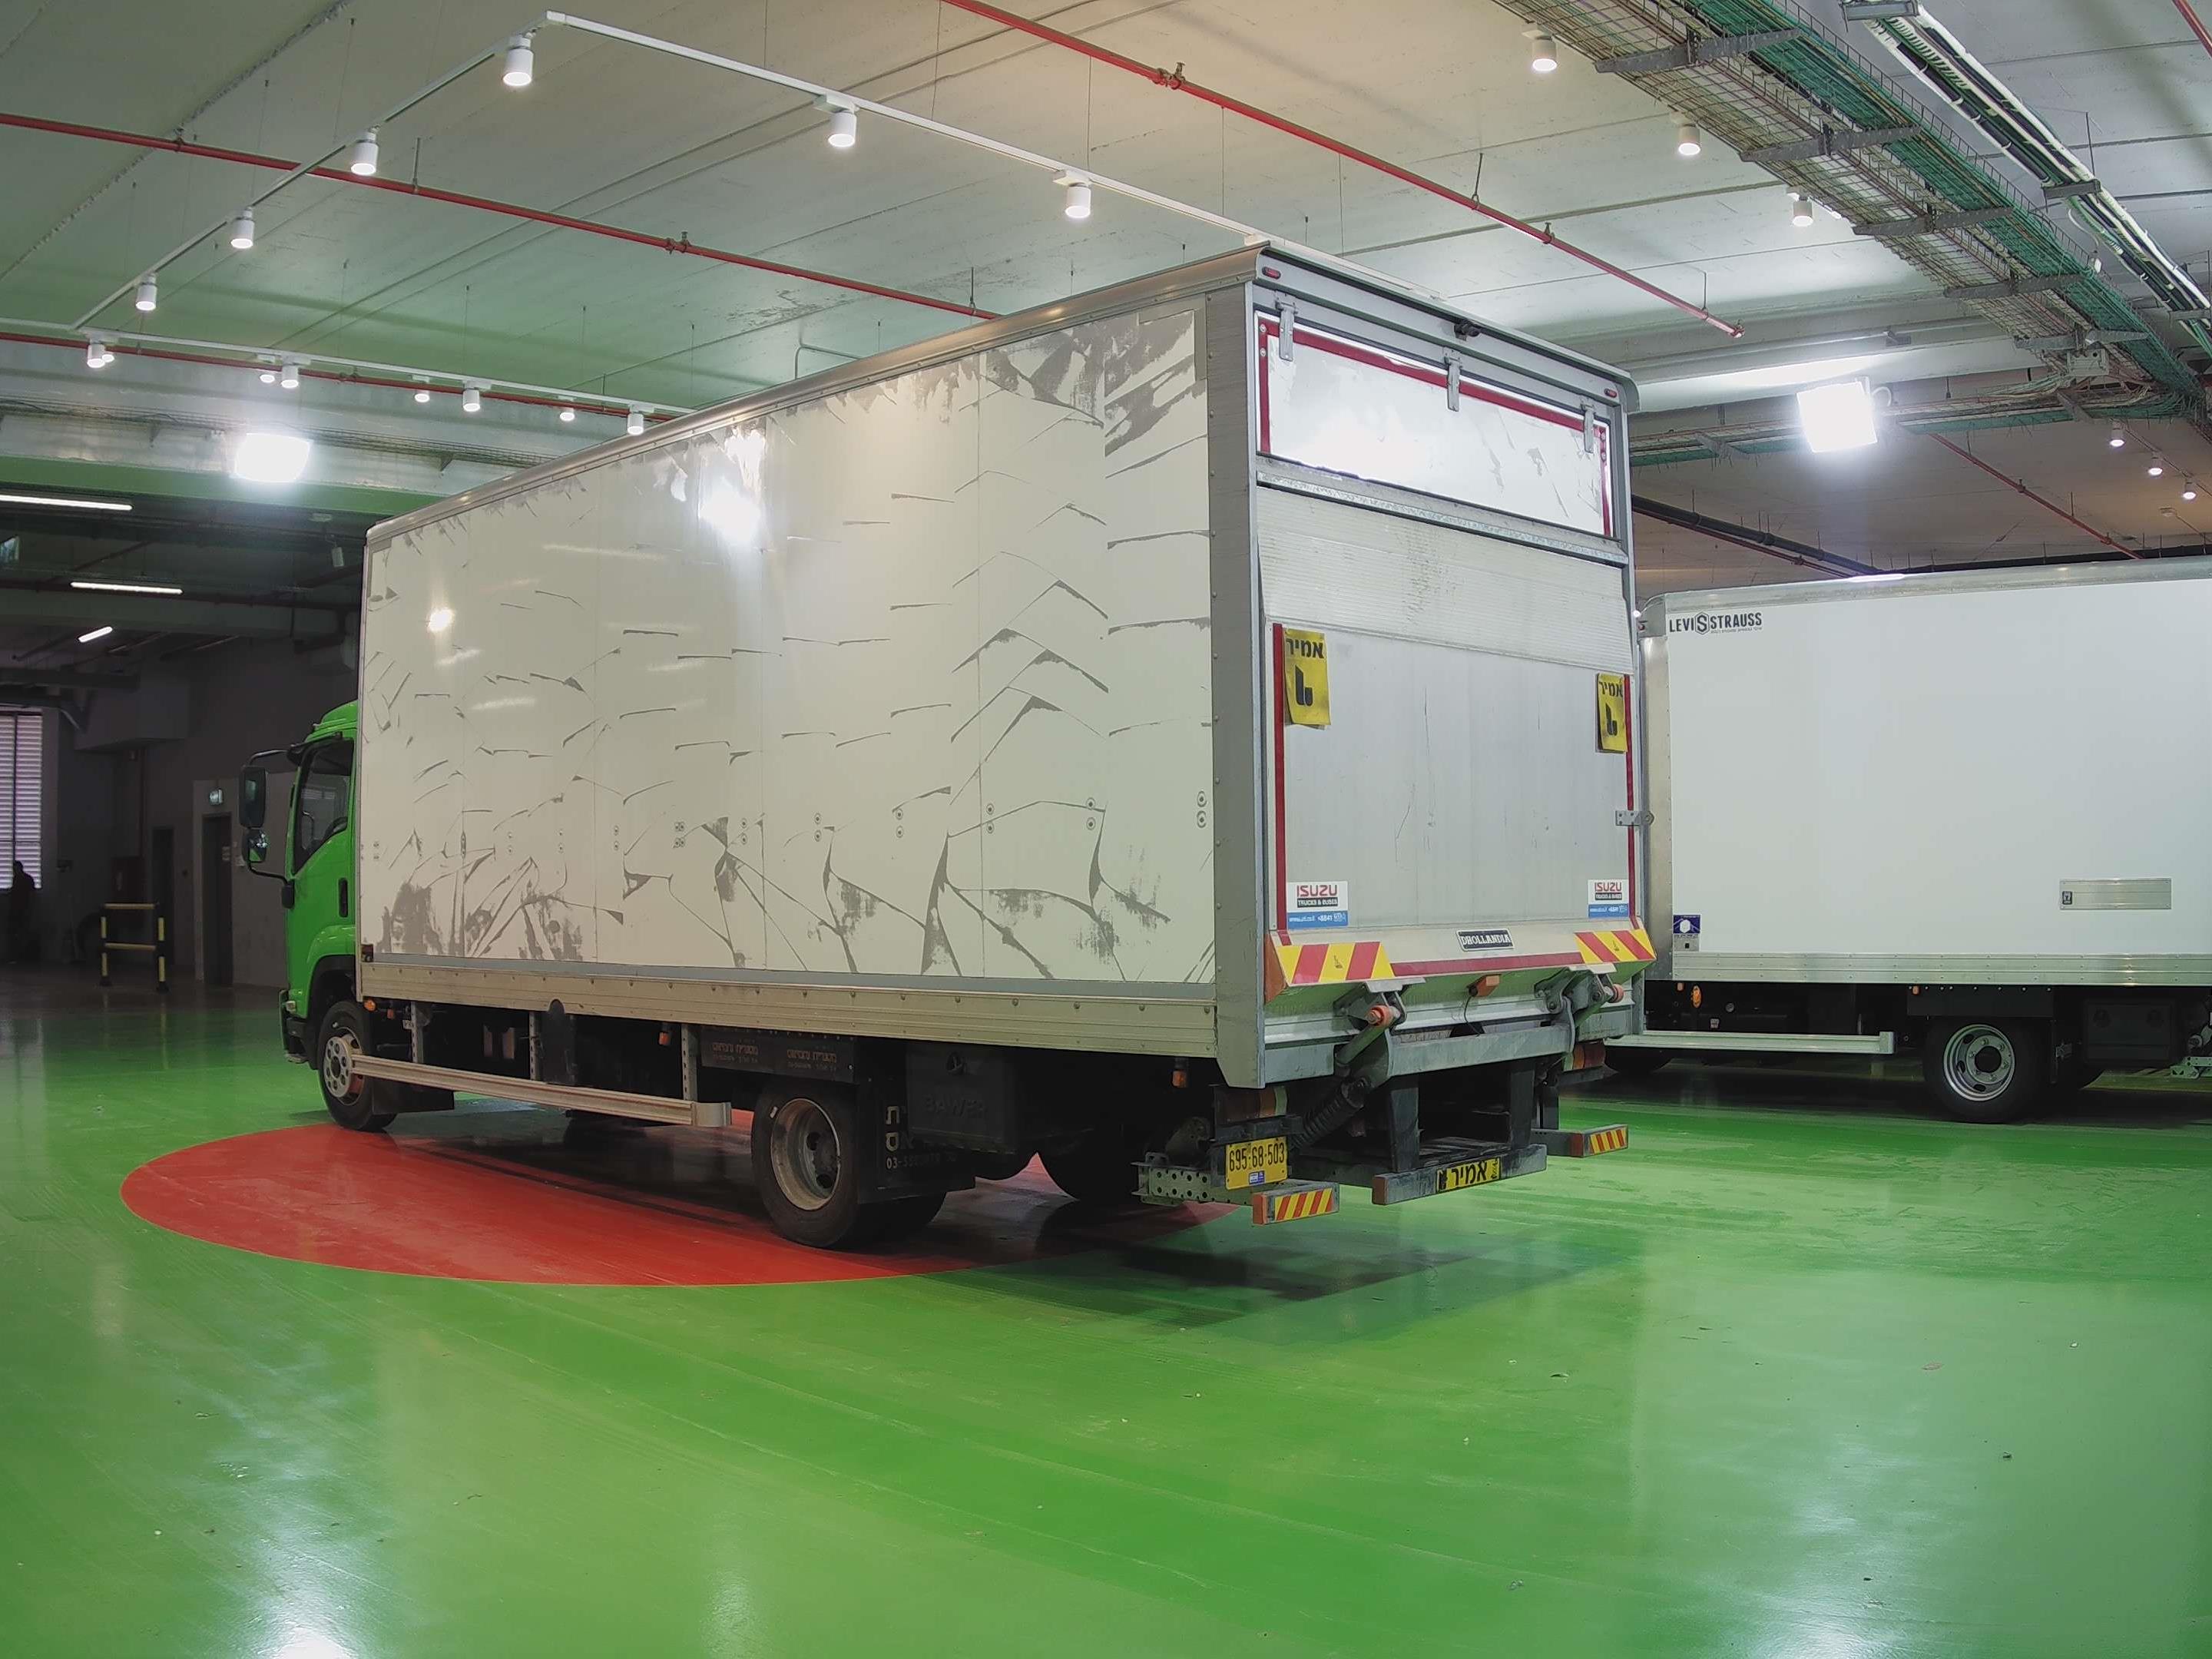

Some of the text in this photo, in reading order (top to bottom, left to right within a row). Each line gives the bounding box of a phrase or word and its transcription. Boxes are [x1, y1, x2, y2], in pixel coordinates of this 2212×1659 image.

[1710, 612, 1762, 629] STRAUSS
[1286, 638, 1324, 659] אמיר
[1599, 681, 1624, 697] אמיר
[1296, 885, 1338, 897] ISUZU
[1594, 882, 1622, 892] ISUZU
[1459, 934, 1511, 945] DHOLLANDIA
[1451, 1161, 1488, 1186] אמיר
